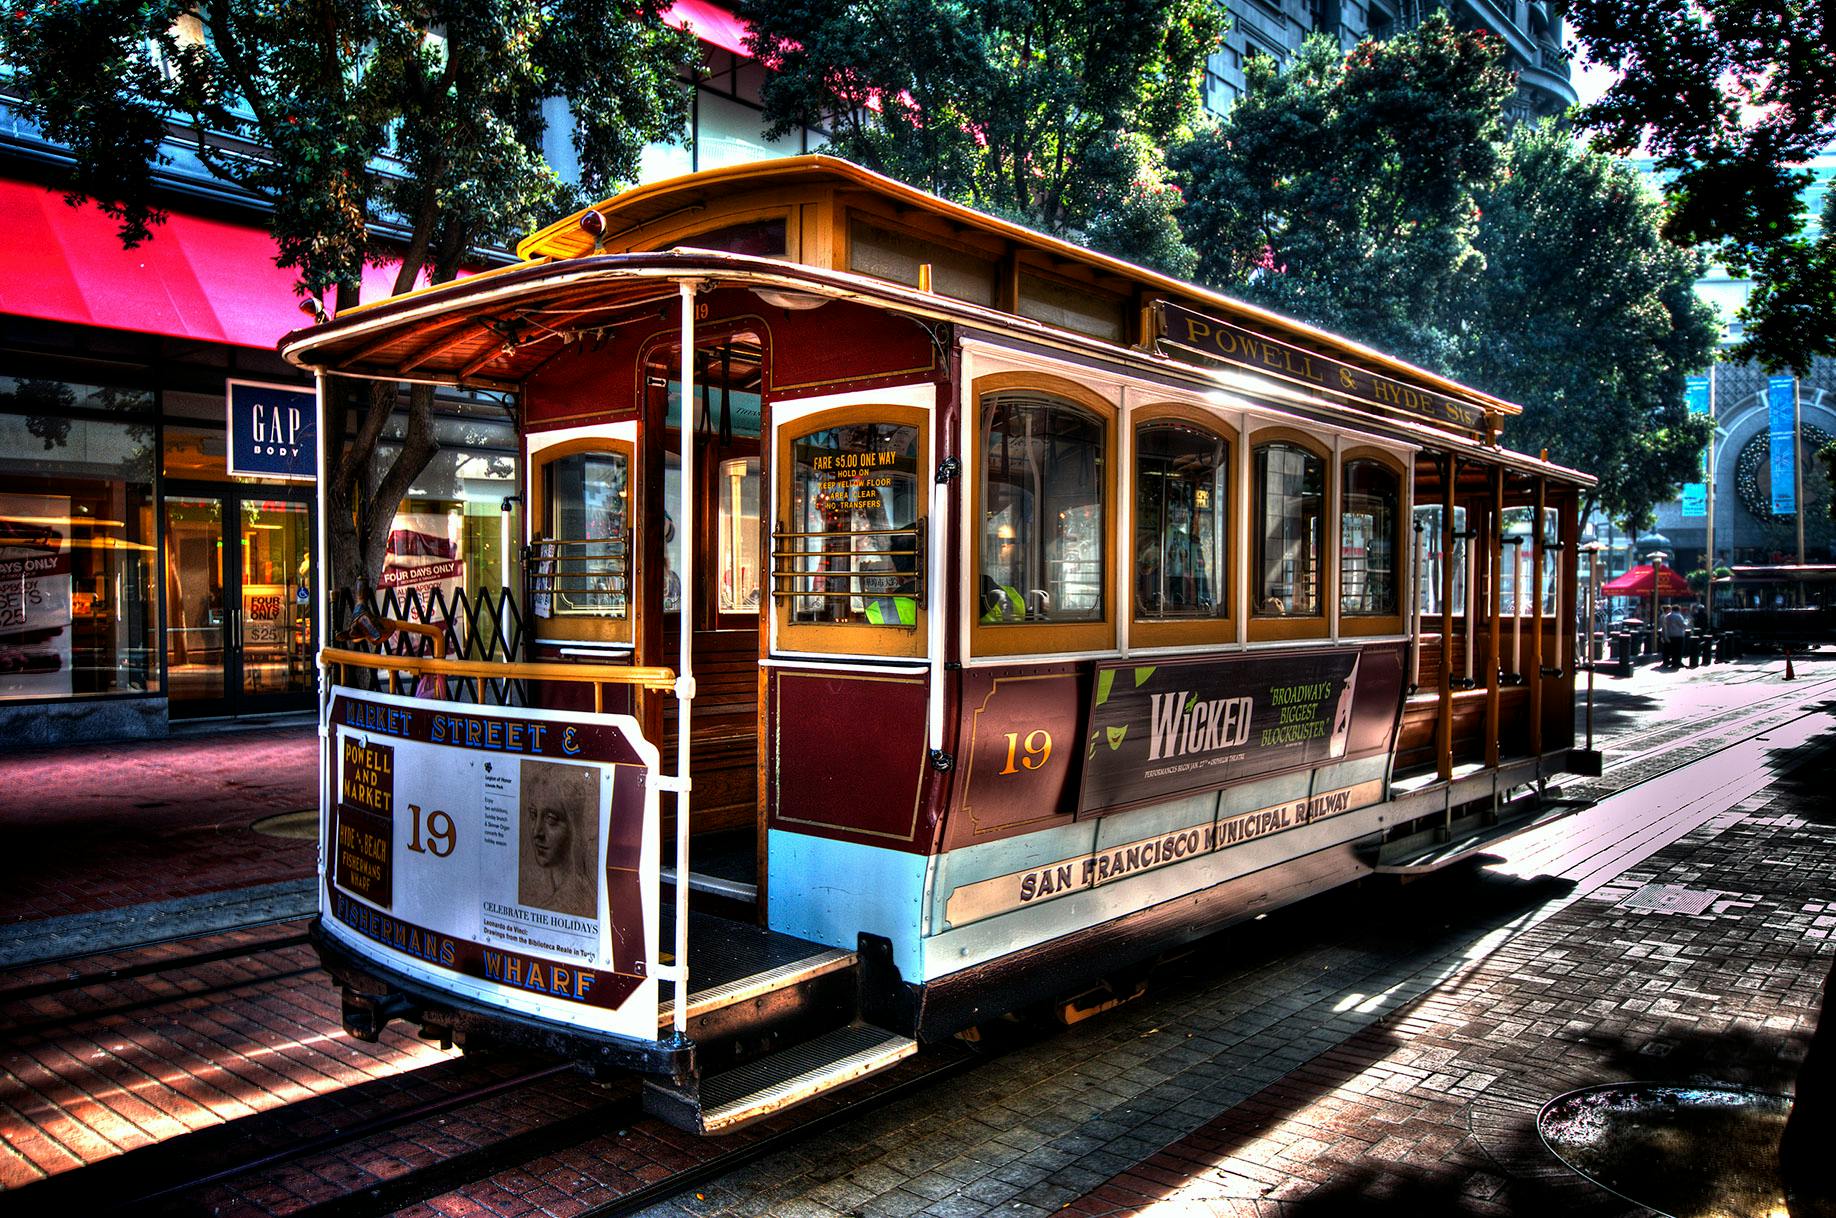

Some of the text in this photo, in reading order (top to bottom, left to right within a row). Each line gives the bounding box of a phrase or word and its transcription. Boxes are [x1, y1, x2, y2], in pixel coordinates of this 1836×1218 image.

[695, 303, 709, 321] 19
[1185, 317, 1324, 384] POWELL
[1339, 367, 1358, 392] &
[1374, 378, 1436, 414] HYDE
[252, 403, 301, 445] GAP
[254, 445, 299, 457] BODY
[813, 451, 897, 470] FARE $5.00 ONE WAY
[837, 468, 870, 478] HOLD ON
[817, 478, 892, 490] KEEP YELLOW FLOOR
[826, 500, 881, 510] NO TRANSFERS
[830, 490, 876, 500] AREA CLEAR
[24, 557, 58, 571] ONLY
[384, 570, 409, 583] FOUR
[410, 567, 432, 579] DAYS
[433, 562, 455, 574] ONLY
[251, 596, 280, 604] FOUR
[251, 603, 280, 612] DAYS
[250, 611, 280, 620] ONLY
[251, 628, 277, 640] $25
[1280, 702, 1319, 724] BIGGEST
[346, 701, 581, 755] MARKET STREET &
[345, 743, 391, 773] POWELL
[998, 729, 1052, 775] 19
[355, 769, 378, 787] AND
[344, 778, 392, 811] MARKET
[406, 803, 457, 858] 19
[340, 823, 355, 850] HYDE
[364, 833, 387, 864] BEACH
[1020, 791, 1351, 902] SAN FRANCISCO MUNICIPAL RAILWAY
[342, 851, 381, 881] FISHERMANS
[350, 873, 371, 892] WHARF
[483, 901, 599, 935] CELEBRATE THE HOLIDAYS
[483, 918, 505, 930] Leonardo
[506, 924, 513, 932] da
[337, 895, 597, 1000] FISHERMANS WHARF
[483, 927, 505, 939] Drawings
[506, 932, 518, 941] from
[518, 935, 527, 944] the
[528, 938, 555, 951] Biblioteca
